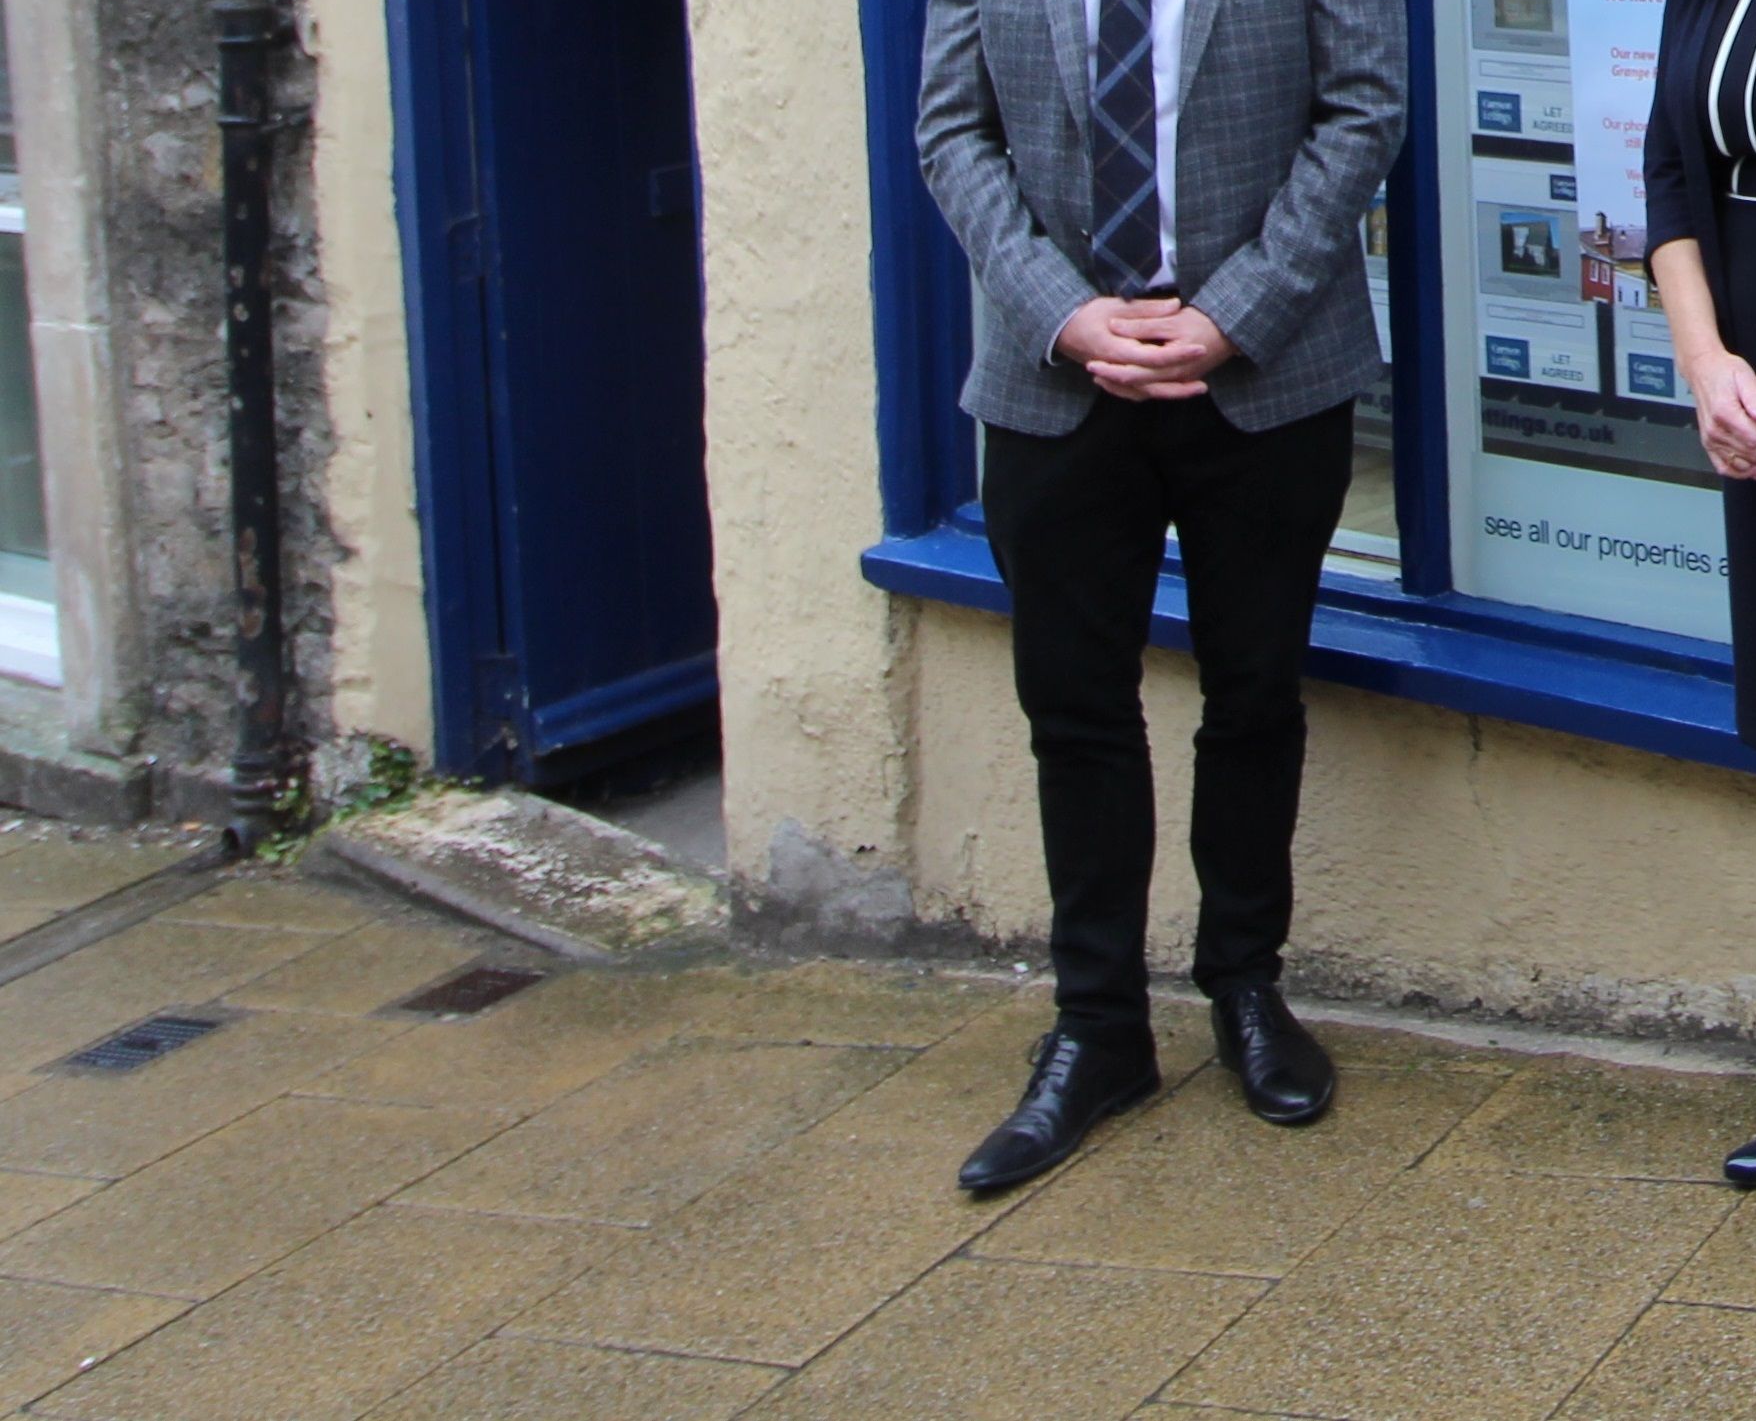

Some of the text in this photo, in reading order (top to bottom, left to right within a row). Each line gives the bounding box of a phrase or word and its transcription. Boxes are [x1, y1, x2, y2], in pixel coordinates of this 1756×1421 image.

[1543, 105, 1563, 118] LET
[1532, 120, 1574, 134] AGREED
[1552, 354, 1571, 366] LET
[1541, 367, 1584, 382] AGREED
[1484, 515, 1522, 539] see
[1529, 520, 1549, 545] all
[1556, 528, 1591, 553] our
[1599, 535, 1711, 575] properties
